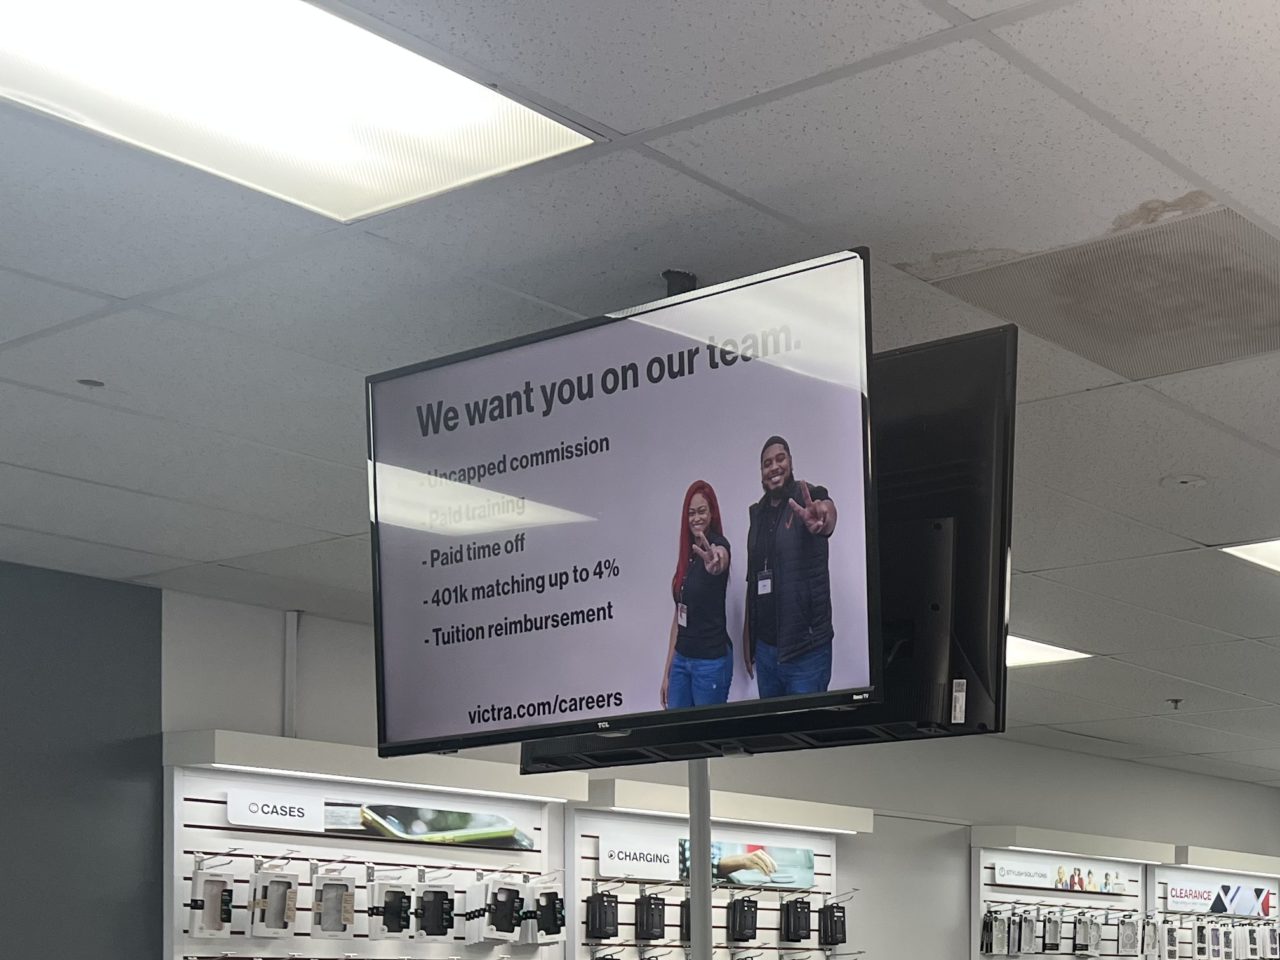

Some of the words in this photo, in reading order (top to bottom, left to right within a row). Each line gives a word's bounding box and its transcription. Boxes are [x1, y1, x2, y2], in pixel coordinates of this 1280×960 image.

[416, 400, 459, 437] We
[465, 381, 534, 426] want
[540, 373, 594, 417] you
[601, 362, 639, 394] on
[647, 345, 700, 383] our
[706, 324, 801, 369] team.
[427, 454, 507, 487] Uncapped
[509, 436, 610, 471] commission
[430, 505, 462, 529] Paid
[465, 496, 525, 521] training
[430, 544, 463, 568] Paid
[466, 541, 501, 561] time
[504, 532, 526, 554] off
[431, 584, 468, 607] 401k
[471, 573, 546, 602] matching
[548, 573, 570, 590] up
[572, 565, 590, 583] to
[593, 558, 620, 579] 4%
[432, 623, 486, 647] Tuition
[488, 601, 614, 638] reimbursement
[467, 691, 623, 725] victra.com/careers
[597, 721, 610, 729] TCL
[261, 803, 305, 818] CASES
[617, 850, 670, 864] CHARGING
[1170, 887, 1212, 901] CLEARANCE
